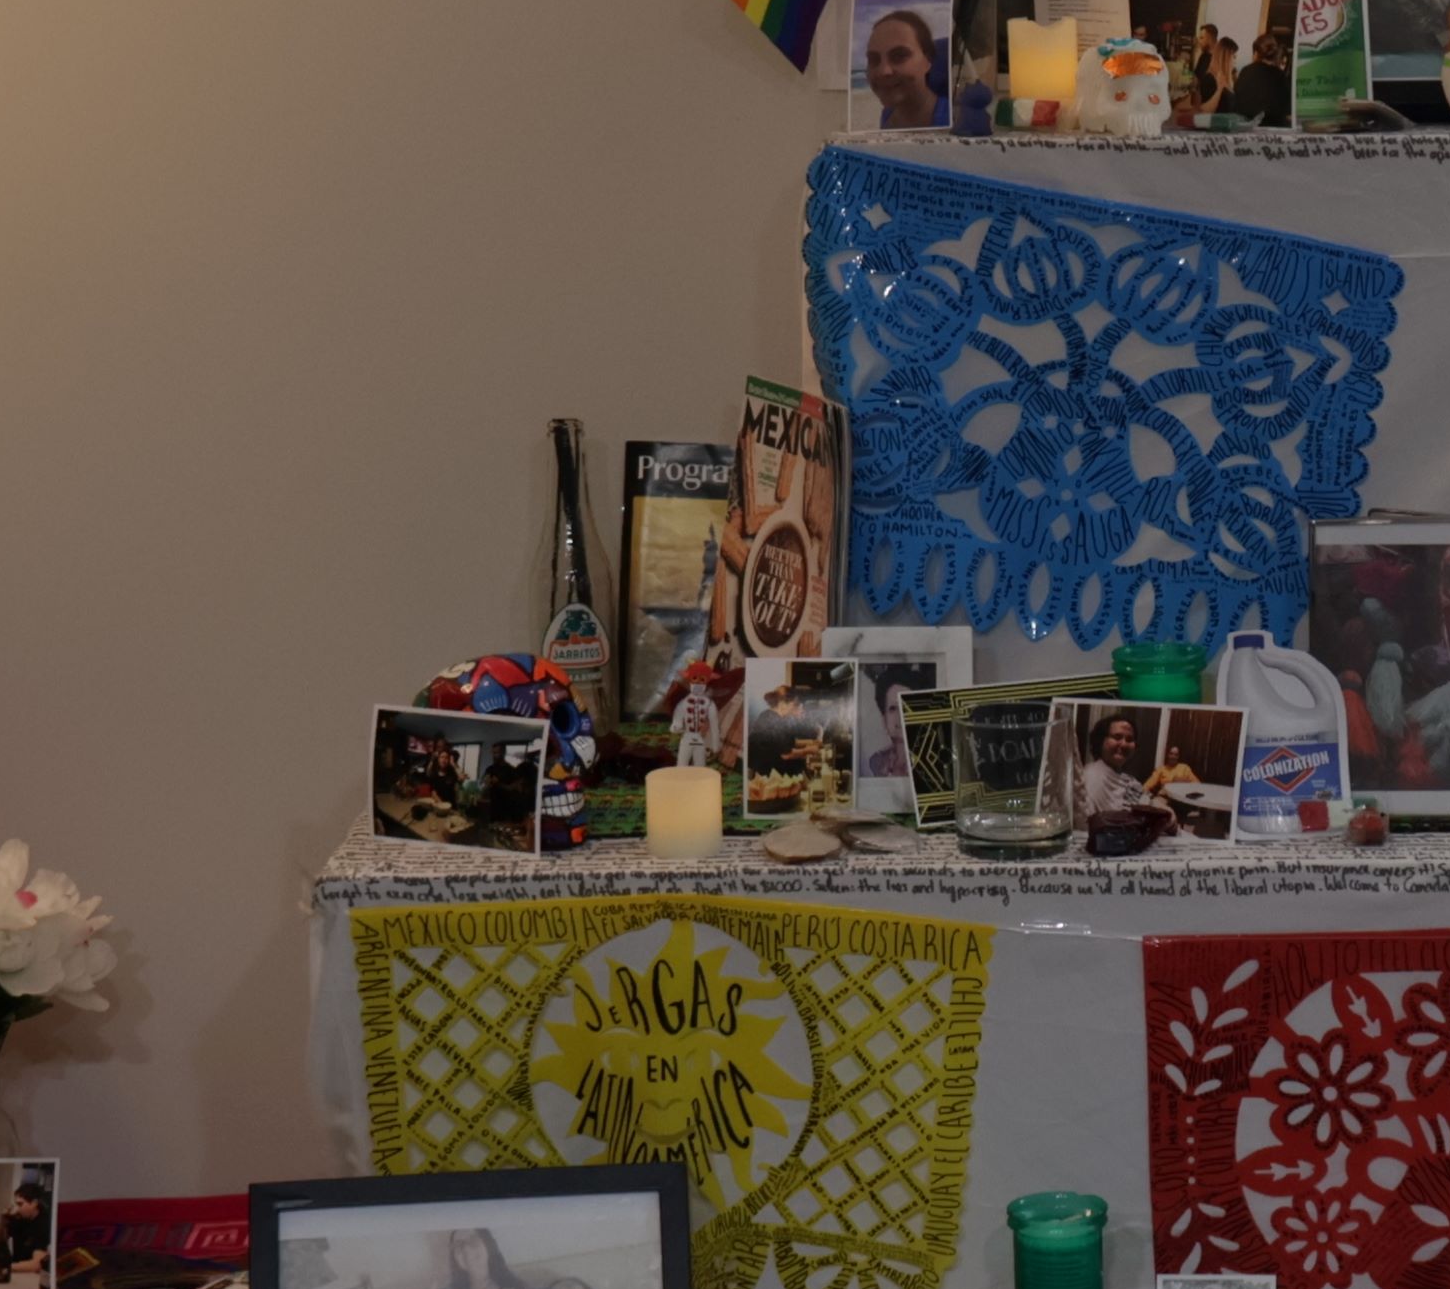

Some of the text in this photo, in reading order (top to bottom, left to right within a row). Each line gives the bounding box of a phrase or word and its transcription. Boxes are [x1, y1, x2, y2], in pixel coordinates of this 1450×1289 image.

[756, 571, 801, 612] TAKE
[753, 599, 798, 635] OUT!
[553, 647, 601, 661] JARRITOS
[1242, 749, 1331, 785] COLONIZATION
[483, 906, 601, 949] COLOMBIA
[849, 919, 917, 961] COSTA
[923, 922, 985, 973] RICA
[573, 957, 744, 1038] JERGAS
[645, 1054, 680, 1084] EN
